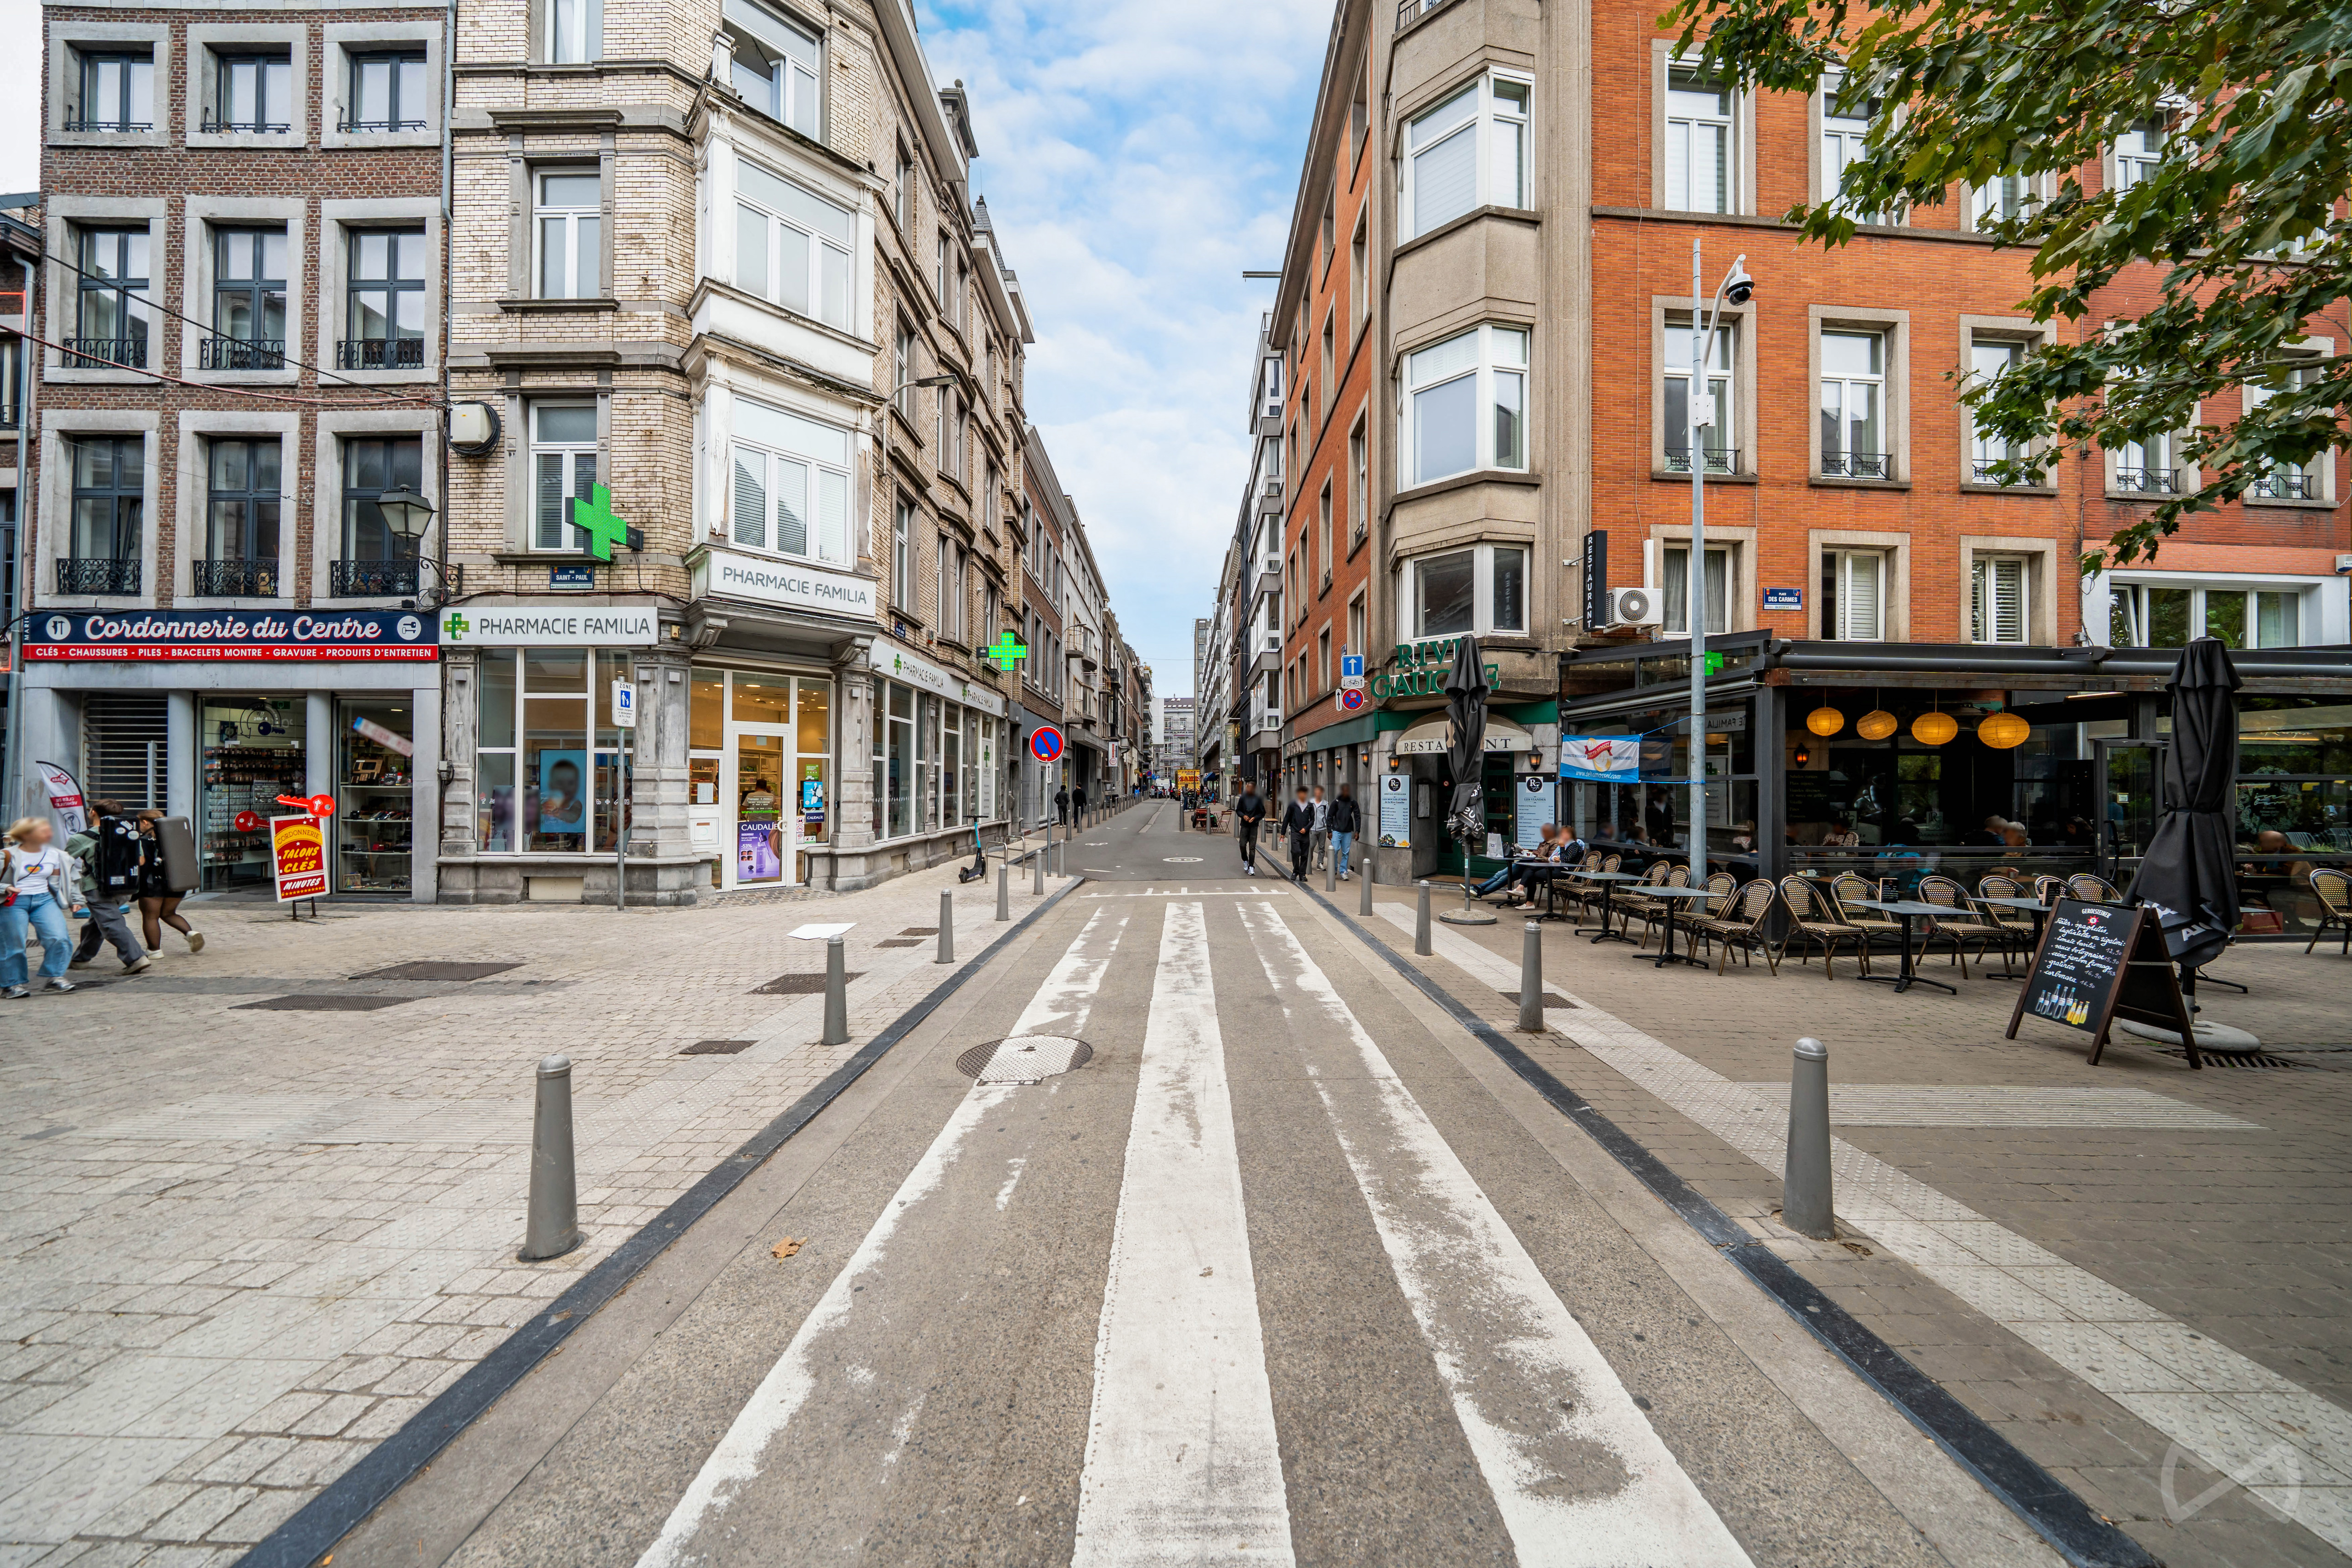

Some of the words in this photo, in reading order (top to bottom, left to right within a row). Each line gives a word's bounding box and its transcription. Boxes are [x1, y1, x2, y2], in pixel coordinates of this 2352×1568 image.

[723, 566, 809, 594] PHARMACIE
[815, 583, 867, 604] FAMILIA
[85, 616, 249, 640] Cordonnerie
[252, 617, 288, 639] du
[293, 616, 382, 640] Centre
[480, 618, 577, 634] PHARMACIE
[584, 618, 651, 634] FAMILIA
[36, 647, 58, 657] CLÉS
[69, 648, 128, 657] CHAUSSURES
[139, 648, 161, 657] PILES
[172, 648, 220, 657] BRACELETS
[225, 648, 262, 657] MONTRE
[273, 648, 317, 657] GRAVURE
[326, 648, 371, 657] PRODUITS
[374, 648, 431, 657] D'ENTRETIEN
[903, 661, 927, 683] PHARMACIE
[928, 672, 944, 689] FAMILIA
[1371, 664, 1501, 698] GAUCE
[967, 690, 983, 705] PHARMACIE
[1404, 738, 1511, 752] RESTANT
[1587, 749, 1597, 758] DELTA
[1597, 742, 1610, 753] MOSSEL
[1576, 770, 1622, 780] www.deltamossel.com
[277, 829, 319, 844] CORDONNERIE
[283, 846, 320, 860] TALONS
[283, 860, 316, 873] CLES
[283, 877, 321, 890] MINUTES
[2081, 908, 2112, 919] GEROLSTEINER
[2058, 926, 2091, 939] tagliatelles
[2057, 936, 2076, 944] tomate
[2076, 940, 2096, 949] basilic
[2071, 946, 2105, 961] bolognaise
[2046, 959, 2075, 971] gratinées
[2085, 970, 2102, 979] 16,90
[2064, 954, 2087, 964] jambon
[2085, 960, 2113, 973] fromage
[2044, 970, 2077, 983] carbonara
